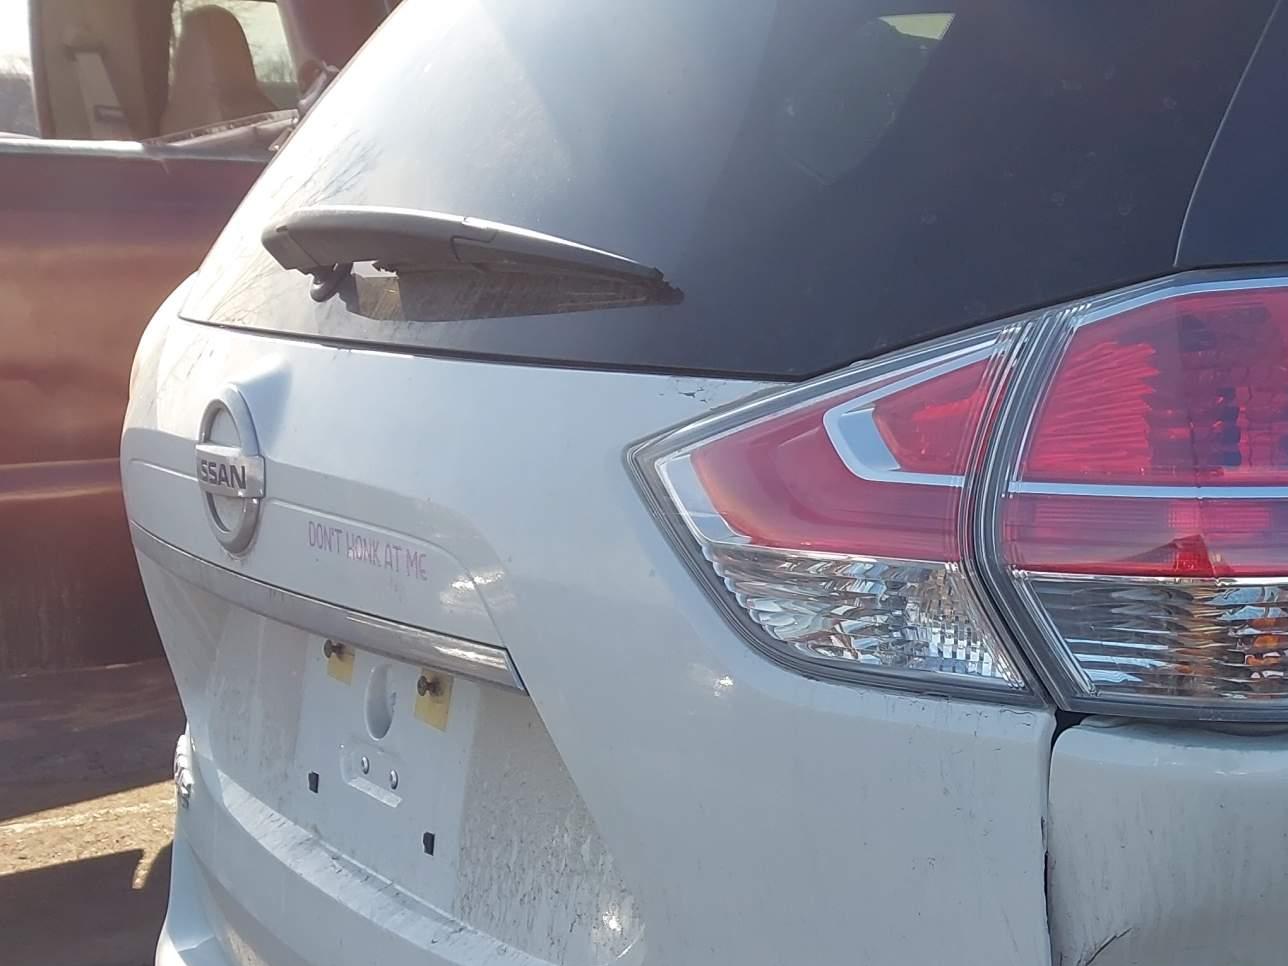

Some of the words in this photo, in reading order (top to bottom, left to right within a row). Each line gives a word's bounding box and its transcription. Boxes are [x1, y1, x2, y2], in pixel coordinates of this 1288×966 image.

[200, 460, 247, 489] SSAN
[308, 520, 342, 553] DON'T
[345, 532, 382, 567] HONK
[384, 543, 402, 573] AT
[406, 549, 428, 581] ME
